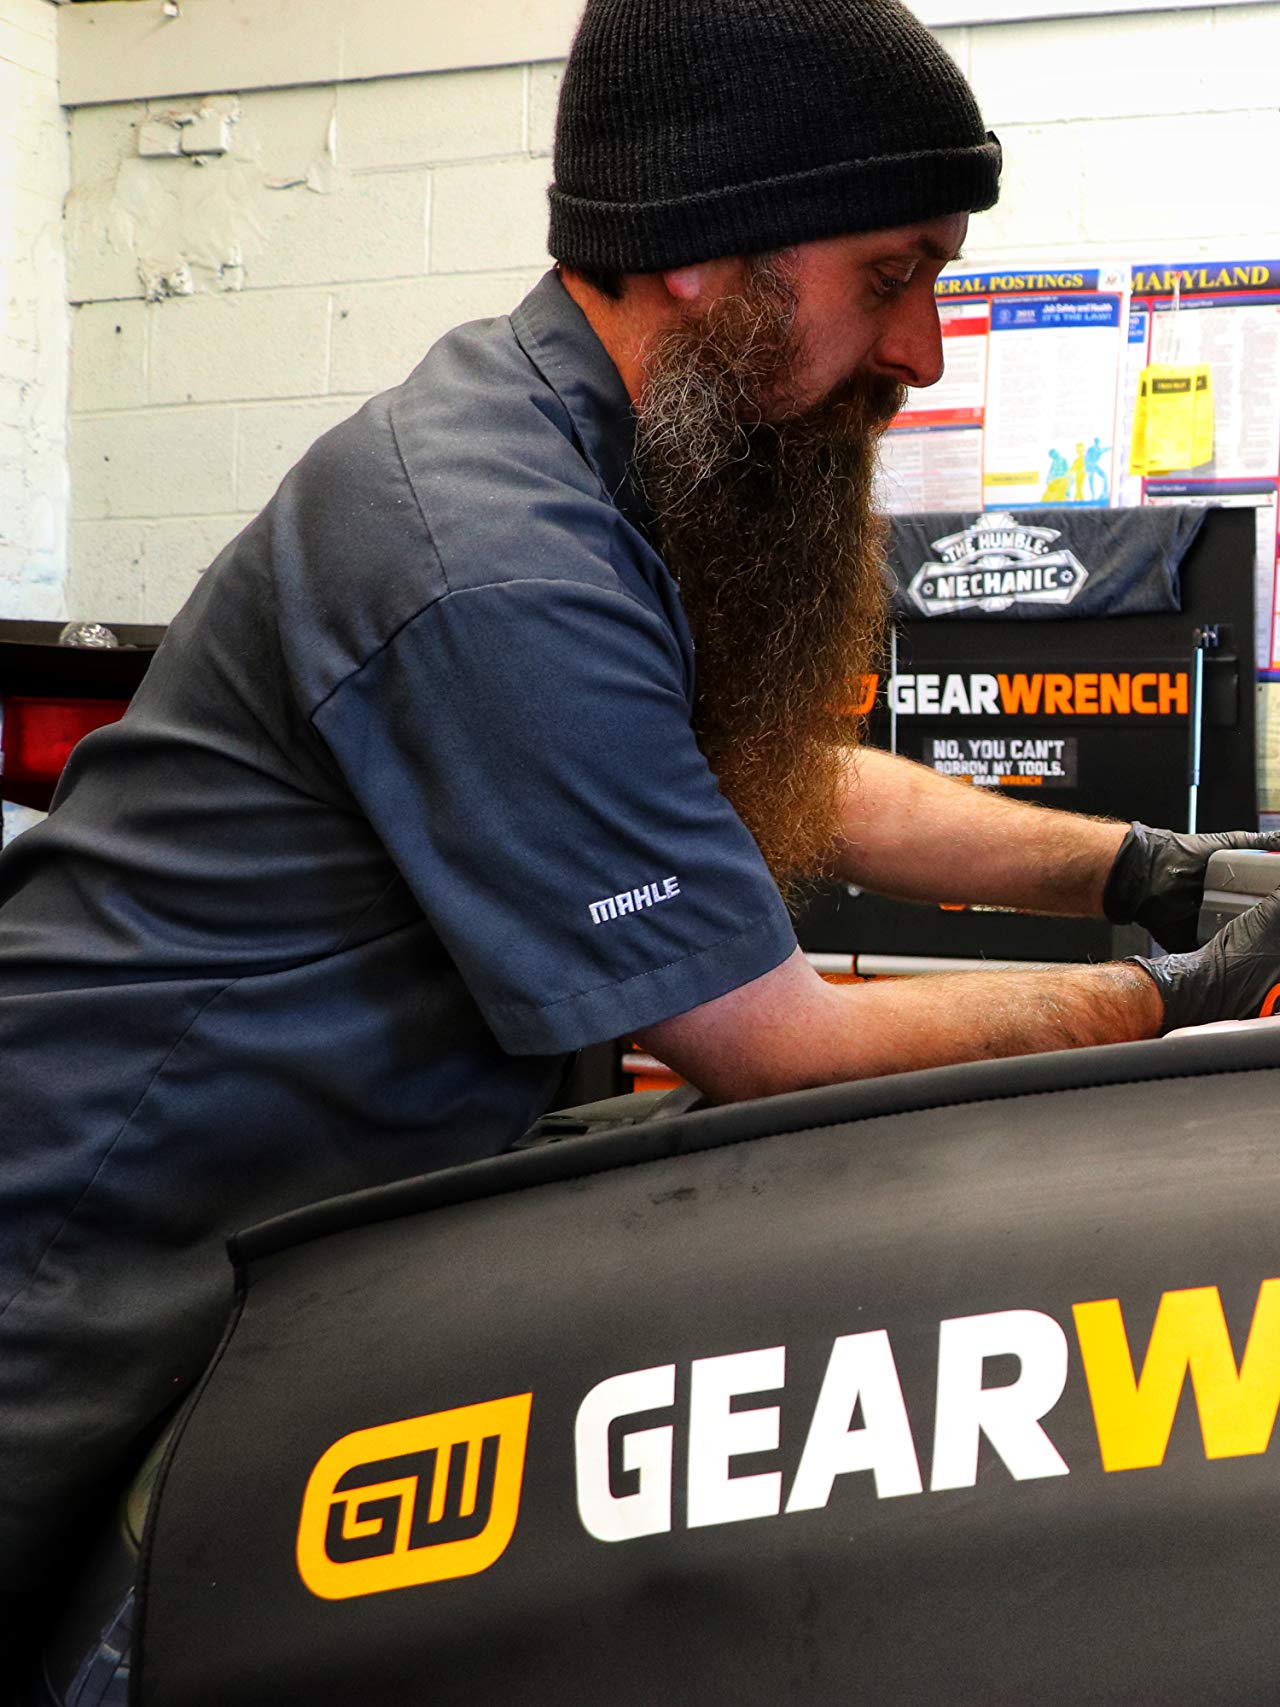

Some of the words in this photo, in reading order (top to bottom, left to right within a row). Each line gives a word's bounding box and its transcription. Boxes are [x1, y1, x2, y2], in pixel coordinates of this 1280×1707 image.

[934, 278, 985, 294] ERAL
[989, 273, 1084, 291] POSTINGS
[948, 537, 975, 561] THE
[979, 532, 1046, 554] HUMBLE
[936, 567, 1058, 598] MECHANIC
[887, 673, 1188, 714] GEARWRENCH
[933, 739, 965, 760] NO,
[968, 739, 1006, 759] YOU
[1010, 739, 1065, 759] CAN'T
[972, 774, 1043, 786] GEARWRENCH
[993, 760, 1014, 775] MY
[1018, 760, 1066, 776] TOOLS.
[588, 876, 681, 925] MAHLE
